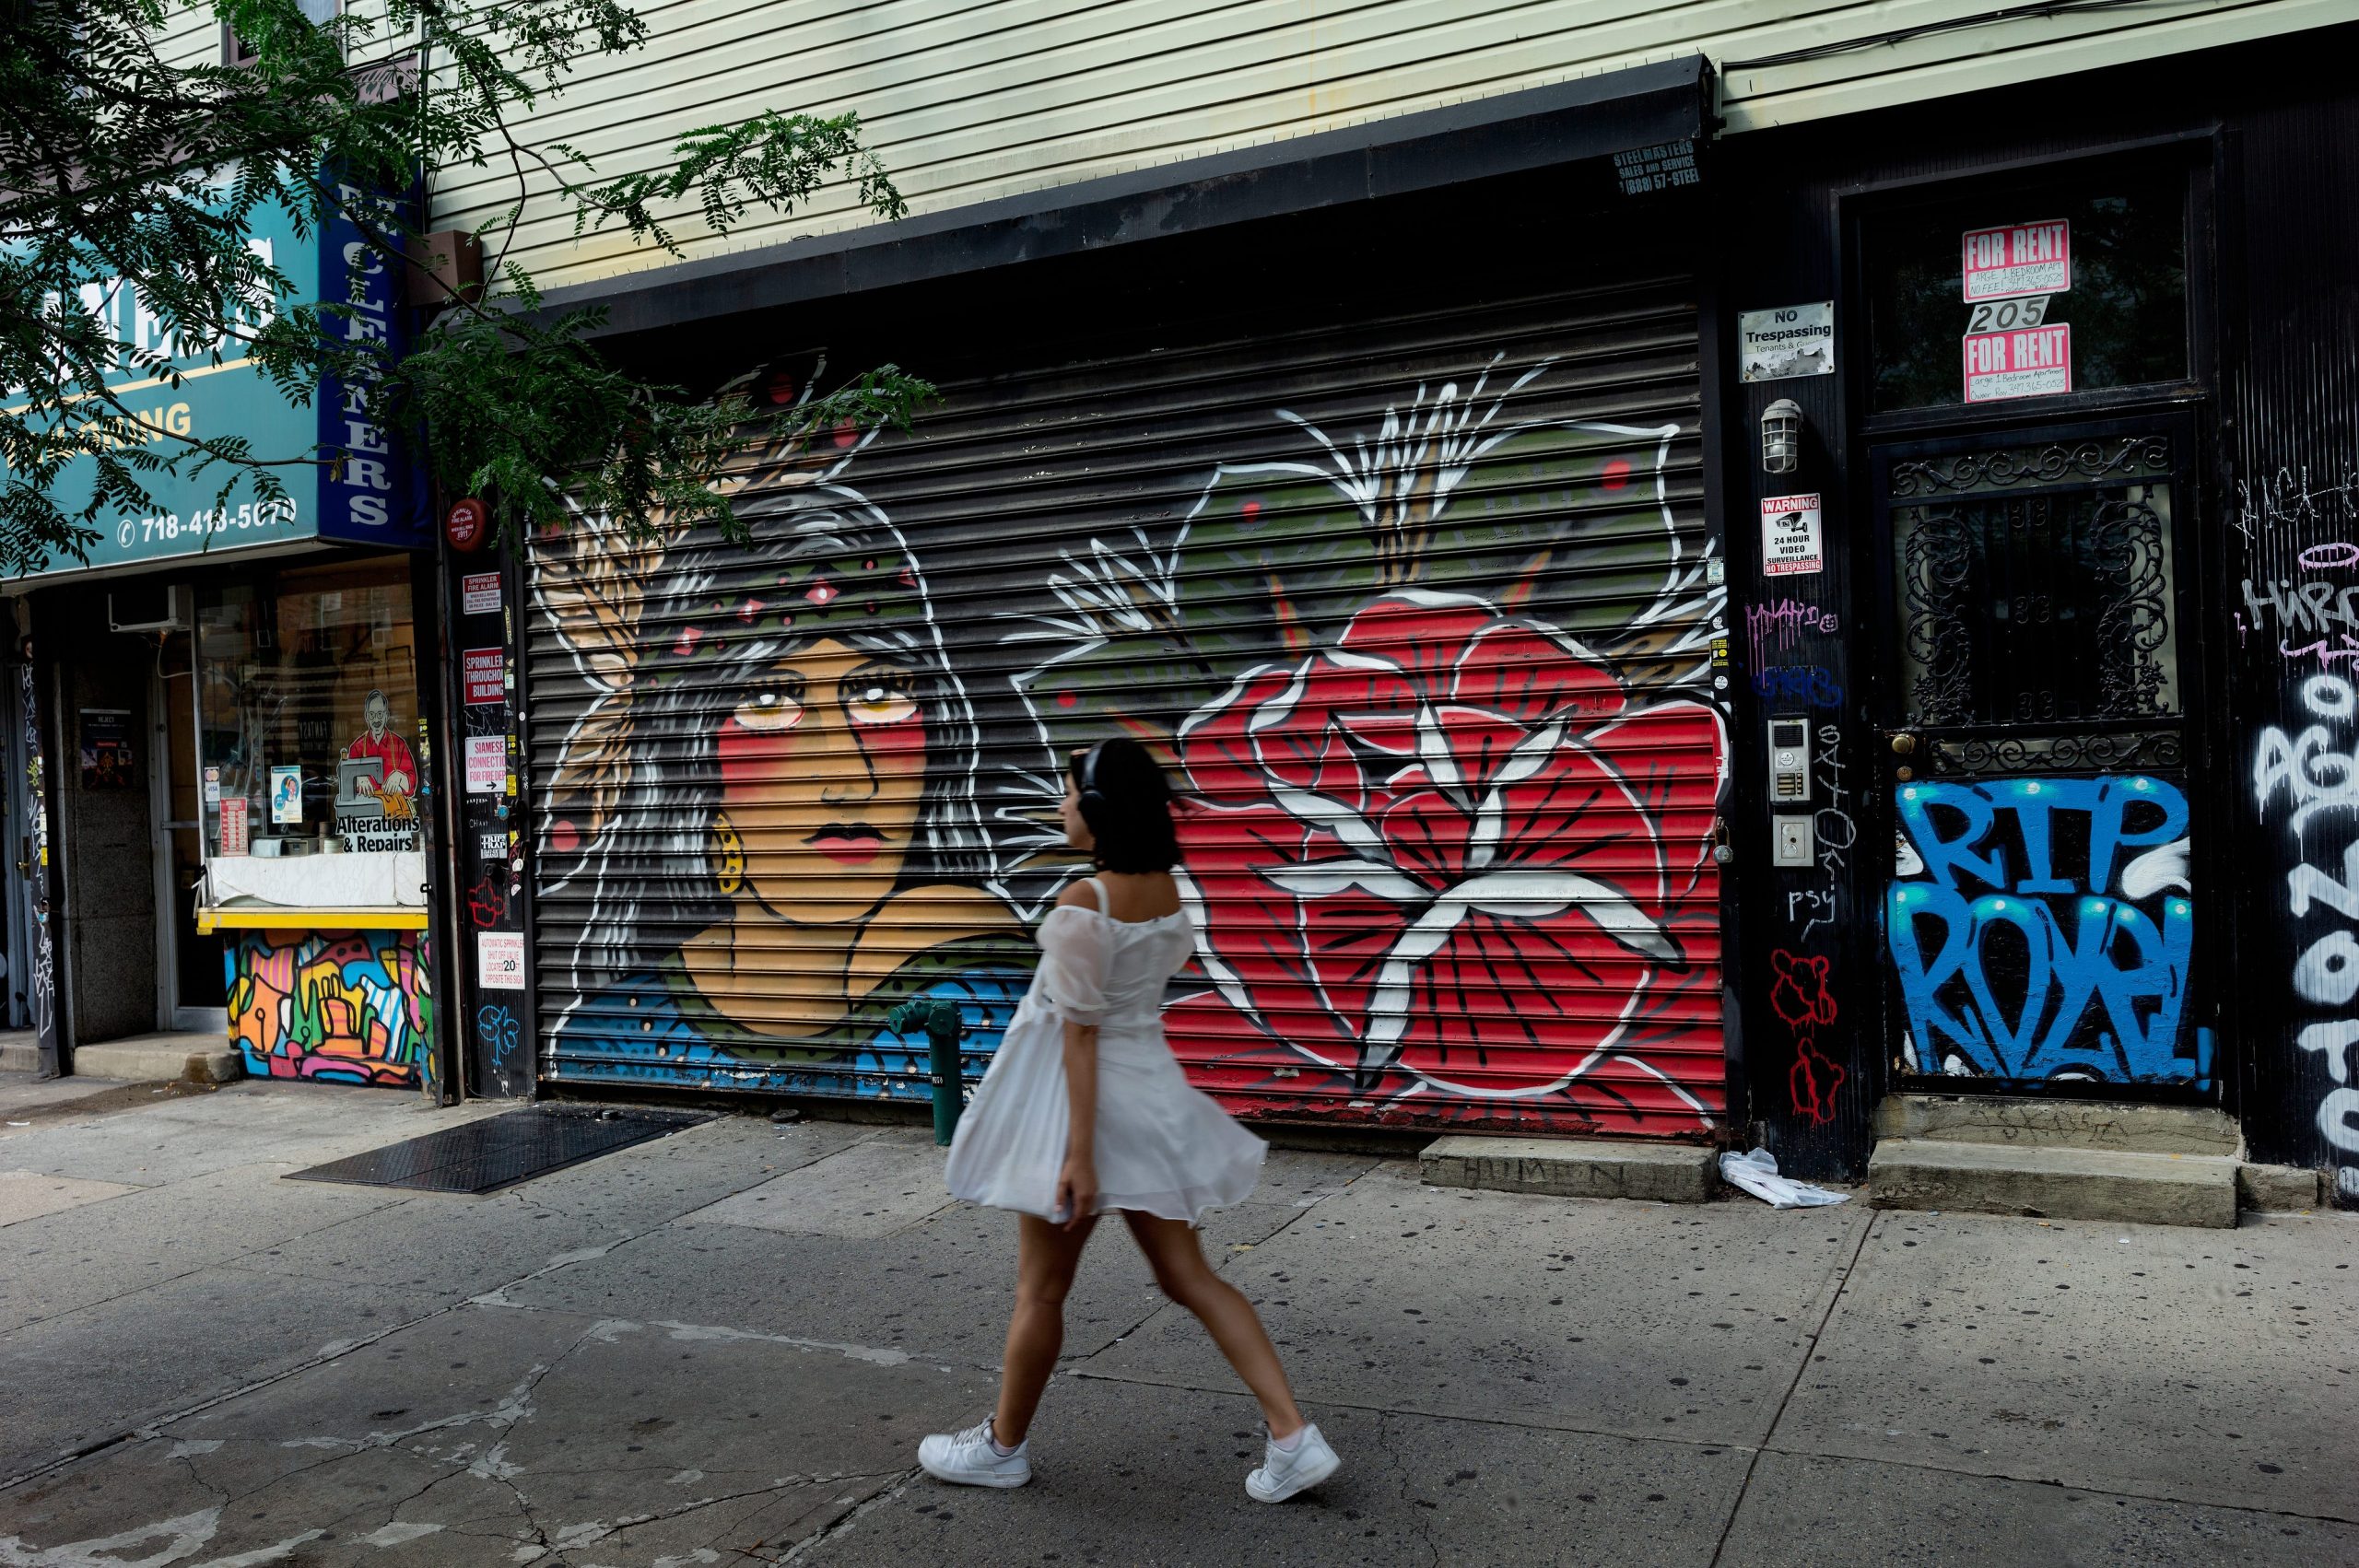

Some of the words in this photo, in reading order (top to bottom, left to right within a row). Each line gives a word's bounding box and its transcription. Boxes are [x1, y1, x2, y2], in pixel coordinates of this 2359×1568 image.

[1614, 141, 1694, 167] STEELMASTERS
[1619, 164, 1644, 179] SALES
[1646, 162, 1660, 173] AND
[1661, 155, 1696, 171] SERVICE
[1966, 232, 2005, 271] FOR
[2013, 224, 2064, 264] RENT
[2010, 263, 2046, 278] BEDROOM
[1775, 310, 1798, 323] NO
[1970, 298, 2045, 333] 205
[1746, 324, 1831, 343] Trespassing
[1755, 344, 1786, 353] Tenants
[1968, 336, 2006, 373] FOR
[2013, 330, 2065, 369] RENT
[1970, 376, 1993, 387] Large
[2002, 372, 2032, 382] Bedroom
[2034, 369, 2064, 379] Apartment
[1764, 497, 1818, 513] WARNING
[1774, 536, 1785, 545] 24
[1787, 534, 1810, 544] HOUR
[1779, 544, 1805, 555] VIDEO
[1766, 554, 1819, 564] SURVEILLANCE
[1766, 565, 1776, 573] NO
[1777, 560, 1821, 572] TRESPASSING
[467, 584, 479, 592] FIRE
[479, 581, 499, 591] ALARM
[468, 575, 498, 585] SPRINKLER
[466, 654, 503, 670] SPRINKLER
[473, 683, 504, 697] BUILDING
[475, 741, 504, 754] SIAMESE
[470, 771, 481, 782] FOR
[482, 770, 495, 782] FIRE
[336, 814, 420, 834] Alterations
[1895, 775, 2191, 894] RIP
[343, 837, 353, 852] &
[357, 833, 413, 852] Repairs
[503, 960, 516, 971] 20
